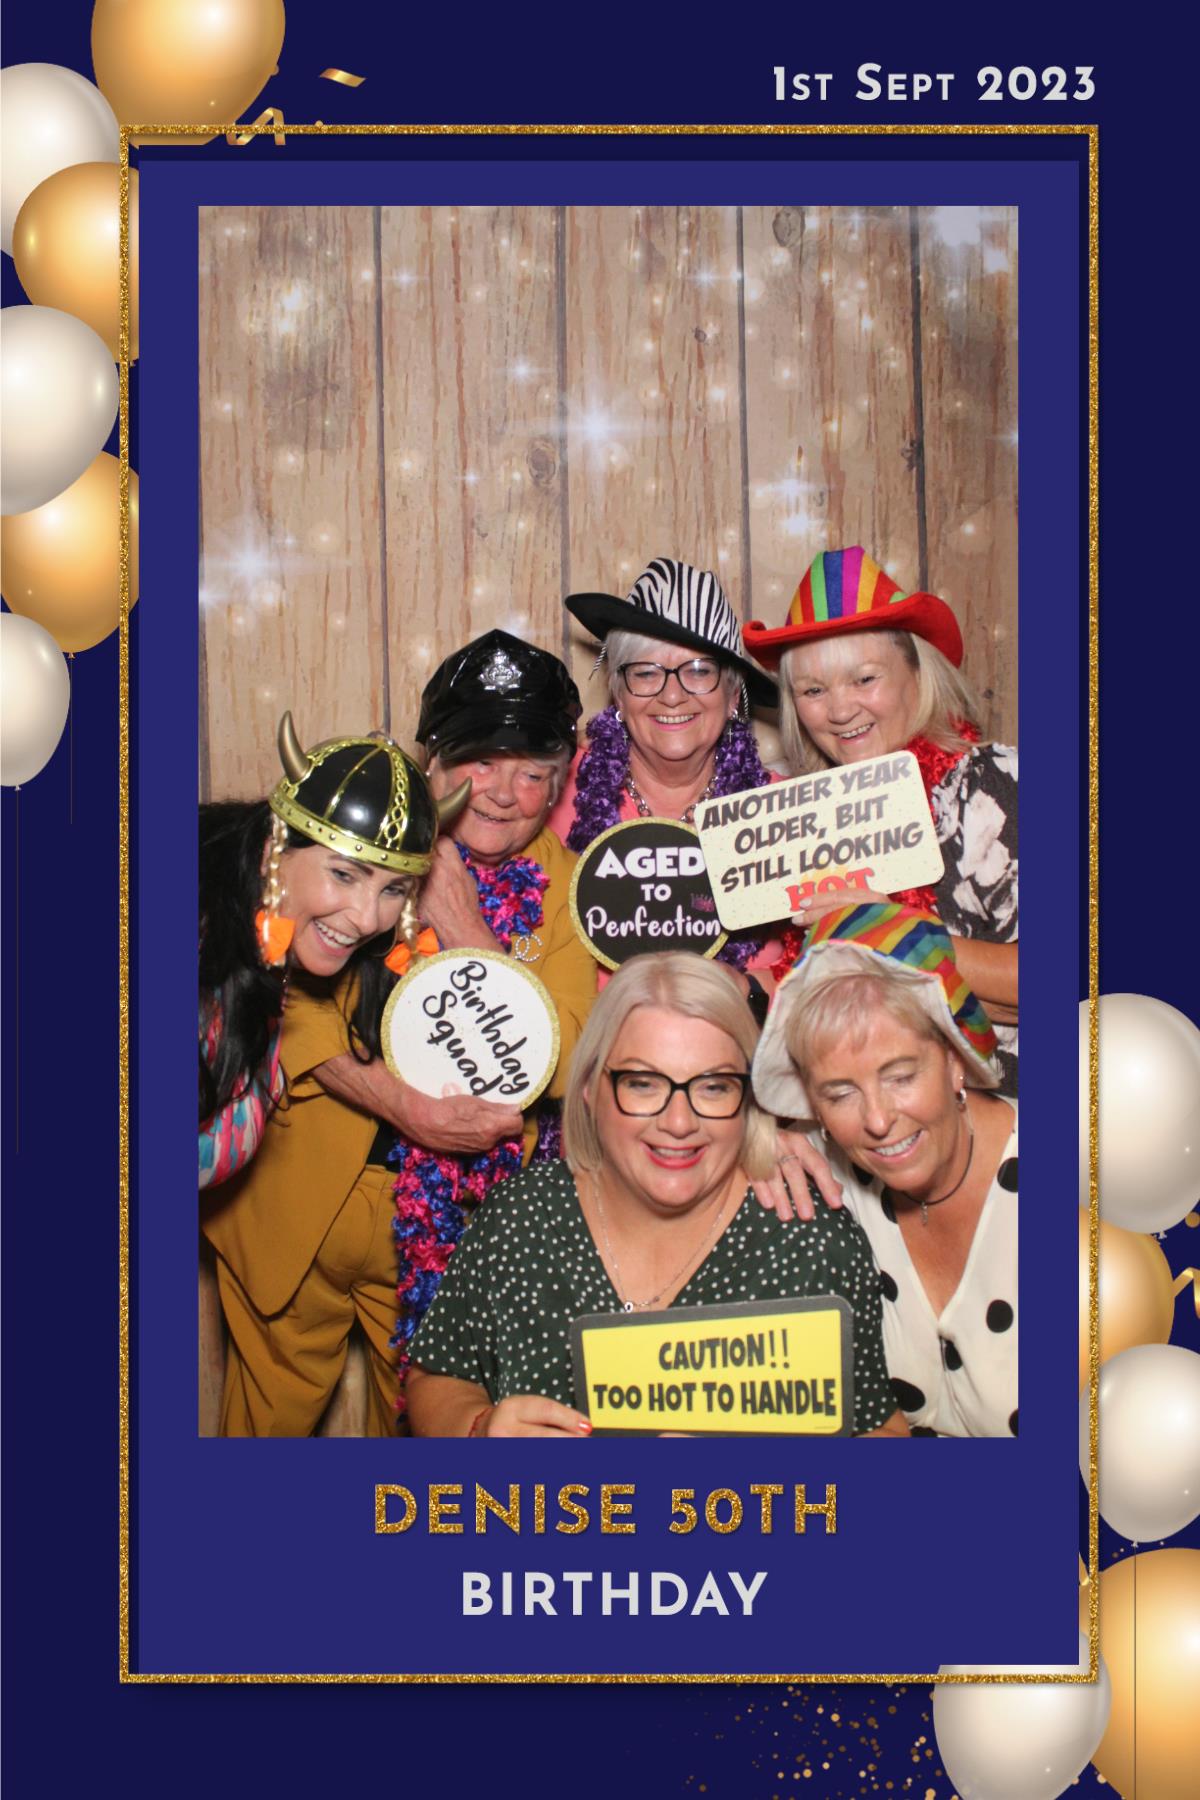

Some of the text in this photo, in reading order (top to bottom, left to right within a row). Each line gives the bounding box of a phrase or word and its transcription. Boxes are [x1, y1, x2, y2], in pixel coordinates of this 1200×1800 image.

[701, 755, 912, 831] ANOTHER YEAR
[734, 794, 889, 855] OLDER, BUT
[594, 847, 706, 879] AGED
[721, 821, 923, 893] STILL LOOKING
[640, 883, 672, 901] TO
[585, 904, 721, 938] Perfection
[422, 989, 504, 1096] Squad
[450, 960, 530, 1096] Birthday
[658, 1328, 790, 1371] CAUTION!!
[593, 1378, 837, 1416] TOO HOT TO HANDLE
